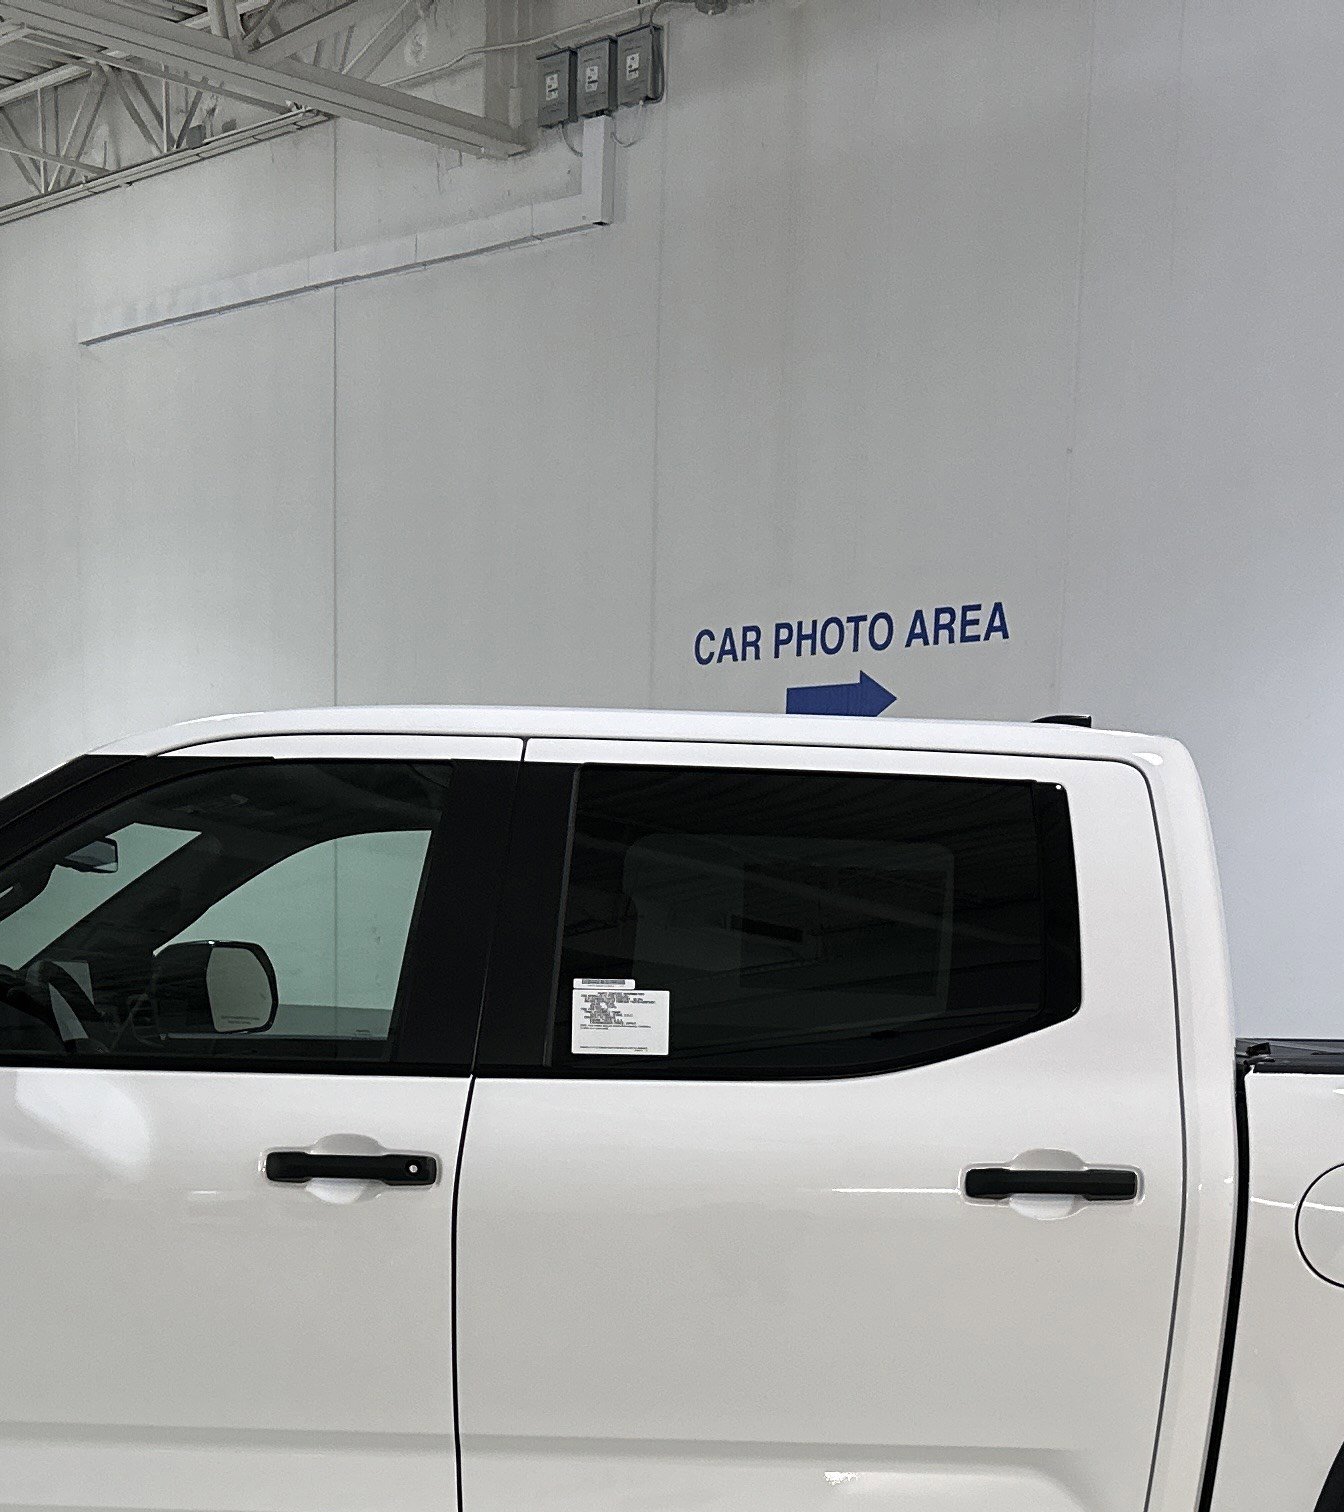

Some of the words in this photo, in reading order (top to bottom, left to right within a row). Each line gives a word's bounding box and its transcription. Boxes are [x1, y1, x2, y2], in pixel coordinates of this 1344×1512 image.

[693, 623, 762, 666] CAR
[773, 611, 895, 660] PHOTO
[903, 600, 1010, 648] AREA
